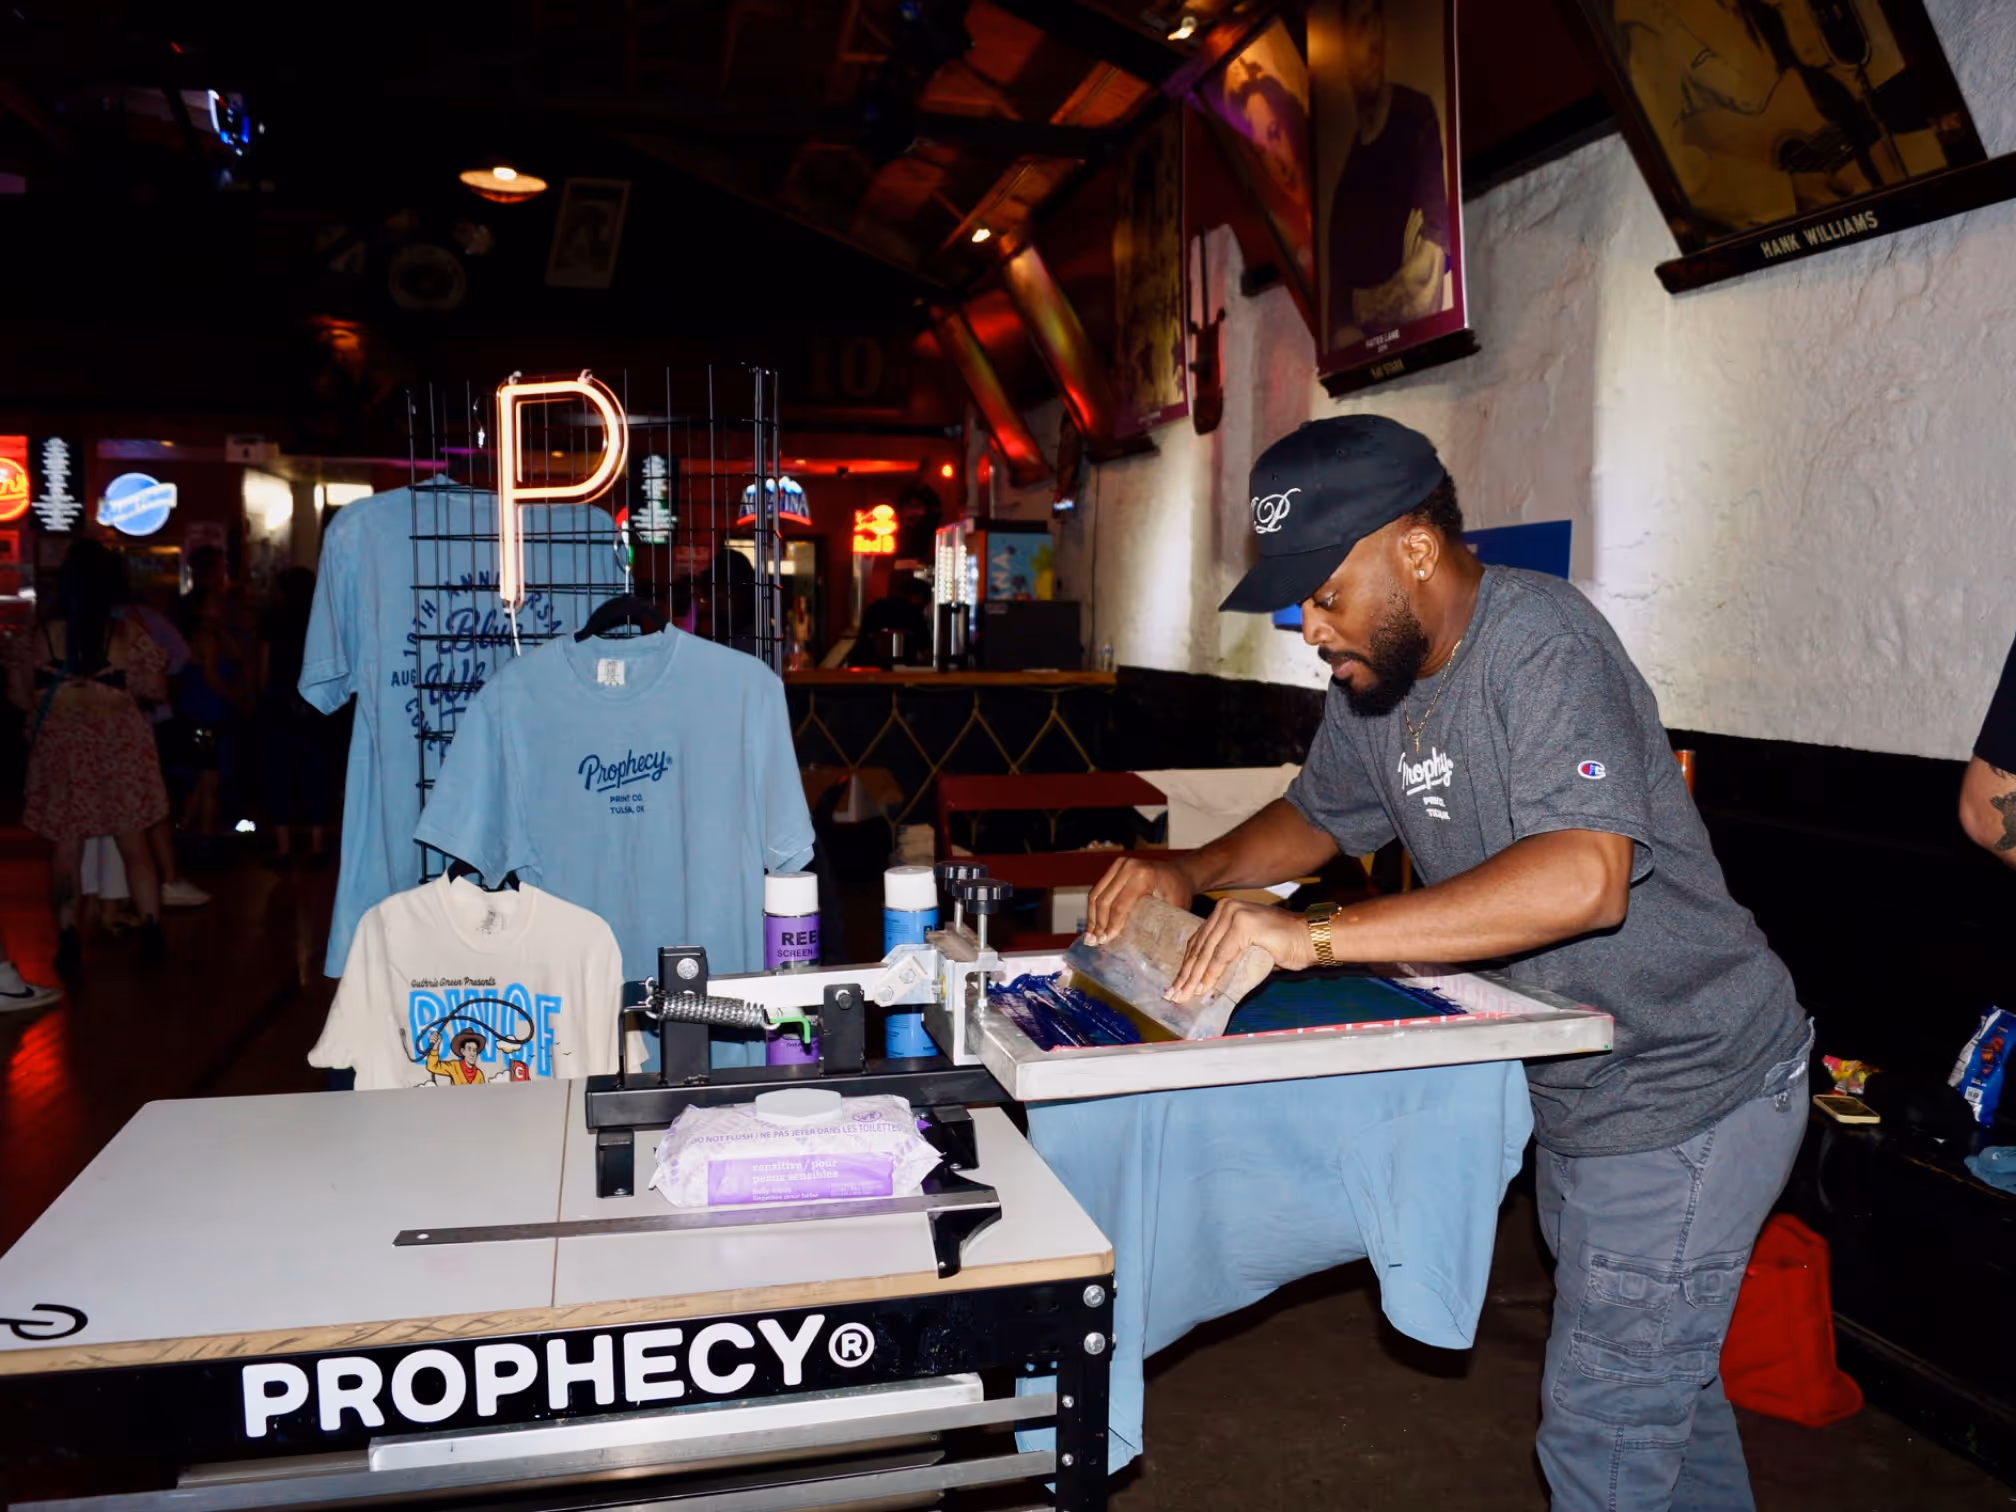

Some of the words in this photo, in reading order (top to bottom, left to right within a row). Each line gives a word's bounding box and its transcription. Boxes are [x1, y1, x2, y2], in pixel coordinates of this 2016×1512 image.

[1760, 233, 1800, 259] HANK
[1802, 210, 1879, 246] WILLIAMS
[497, 378, 629, 602] P
[777, 949, 813, 958] SCREEN
[440, 977, 462, 987] Green
[464, 976, 496, 986] Presents
[706, 1135, 724, 1143] NOT
[726, 1132, 753, 1141] FLUSH
[760, 1130, 771, 1138] NE
[774, 1128, 790, 1137] PAS
[791, 1128, 815, 1137] JETER
[817, 1126, 840, 1135] DANS
[842, 1124, 857, 1133] LES
[811, 1159, 838, 1171] pour
